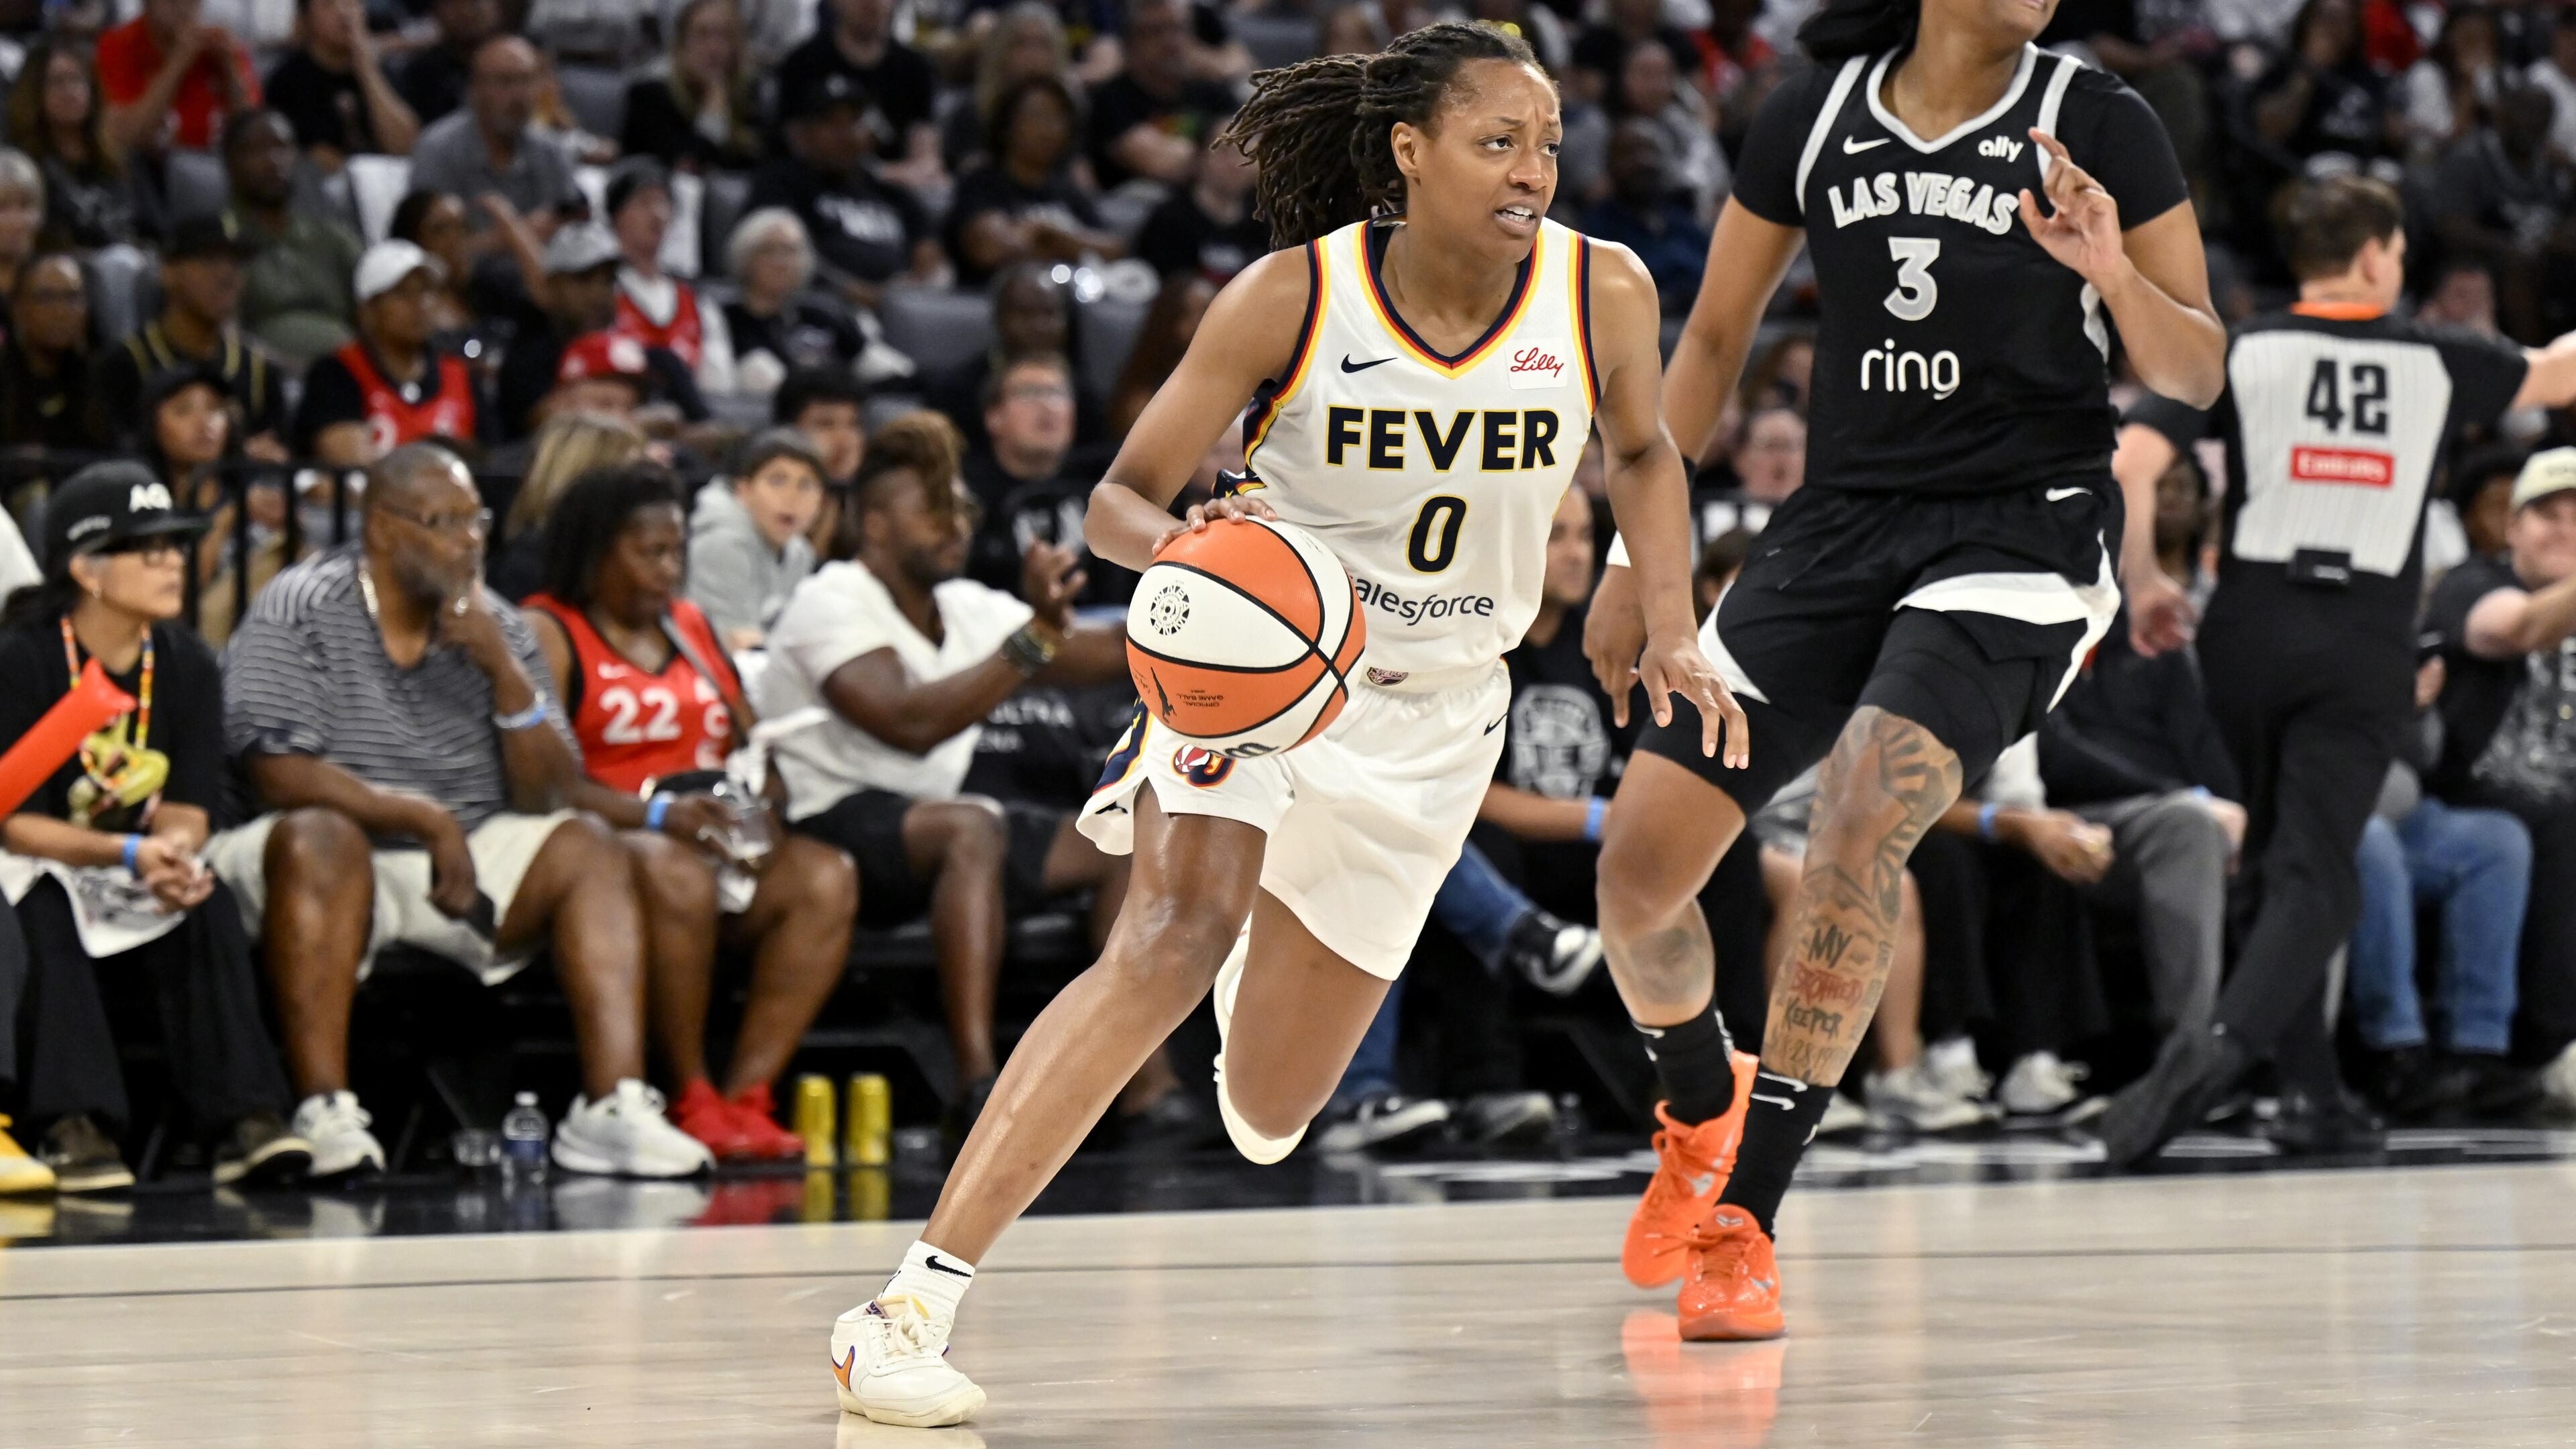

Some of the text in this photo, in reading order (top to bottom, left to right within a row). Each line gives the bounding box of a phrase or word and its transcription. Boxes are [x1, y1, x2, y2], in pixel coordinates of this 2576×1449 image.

[1978, 135, 2025, 163] ally
[1827, 171, 2019, 235] LAS VEGAS
[1883, 236, 1941, 321] 3
[1510, 347, 1564, 378] Lilly
[1860, 338, 1960, 400] ring
[2305, 359, 2387, 435] 42
[1326, 405, 1560, 473] FEVER
[1405, 494, 1468, 575] 0
[1350, 576, 1495, 626] alesforce
[598, 686, 682, 746] 22
[1808, 924, 1852, 969] MY
